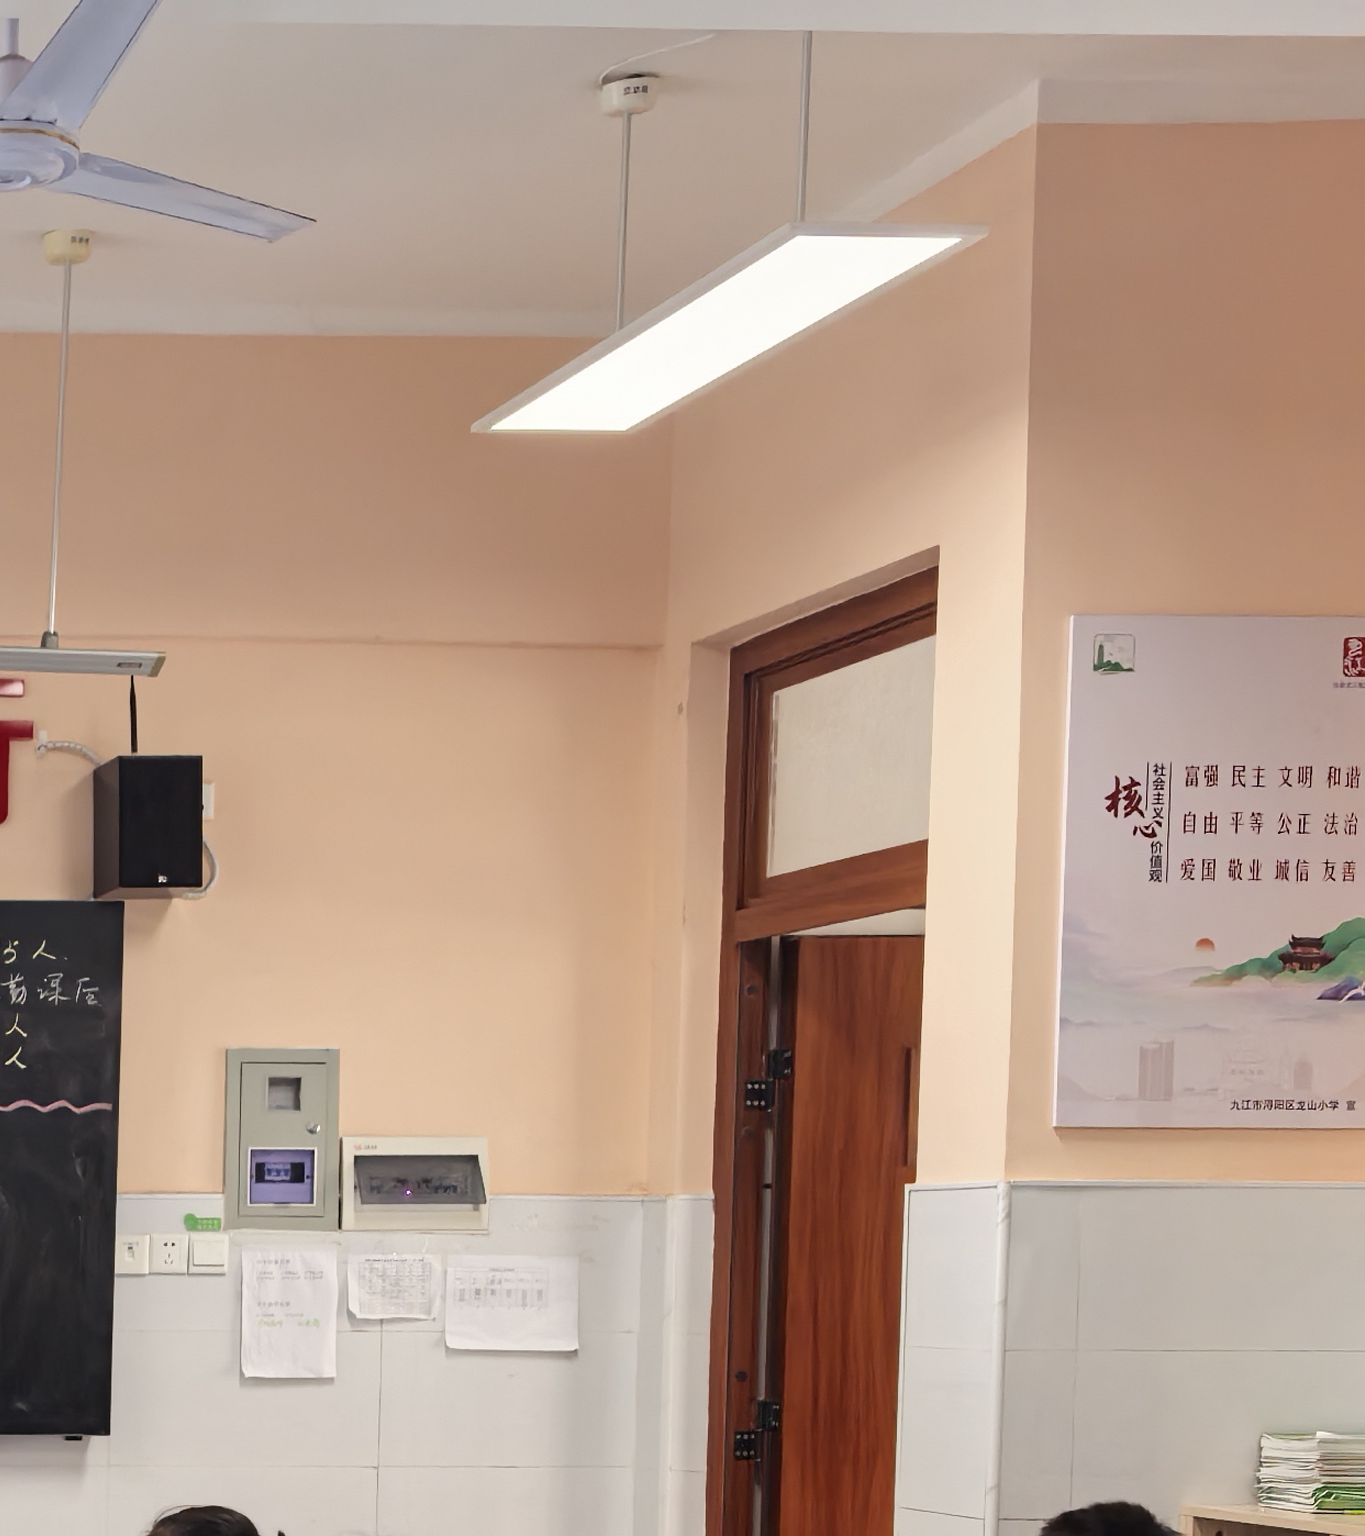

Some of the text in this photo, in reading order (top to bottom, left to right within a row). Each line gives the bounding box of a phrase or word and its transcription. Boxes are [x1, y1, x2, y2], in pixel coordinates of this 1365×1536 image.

[1184, 764, 1362, 789] 富强 民主 文明 和谐
[1151, 763, 1167, 820] 社会主义
[1104, 775, 1164, 839] 核心
[1182, 811, 1359, 835] 自由 平等 公正 法治
[1148, 840, 1164, 883] 价值观
[1180, 858, 1357, 883] 爱国 敬业 诚信 友善
[5, 1012, 28, 1037] 人
[4, 1046, 27, 1070] 人
